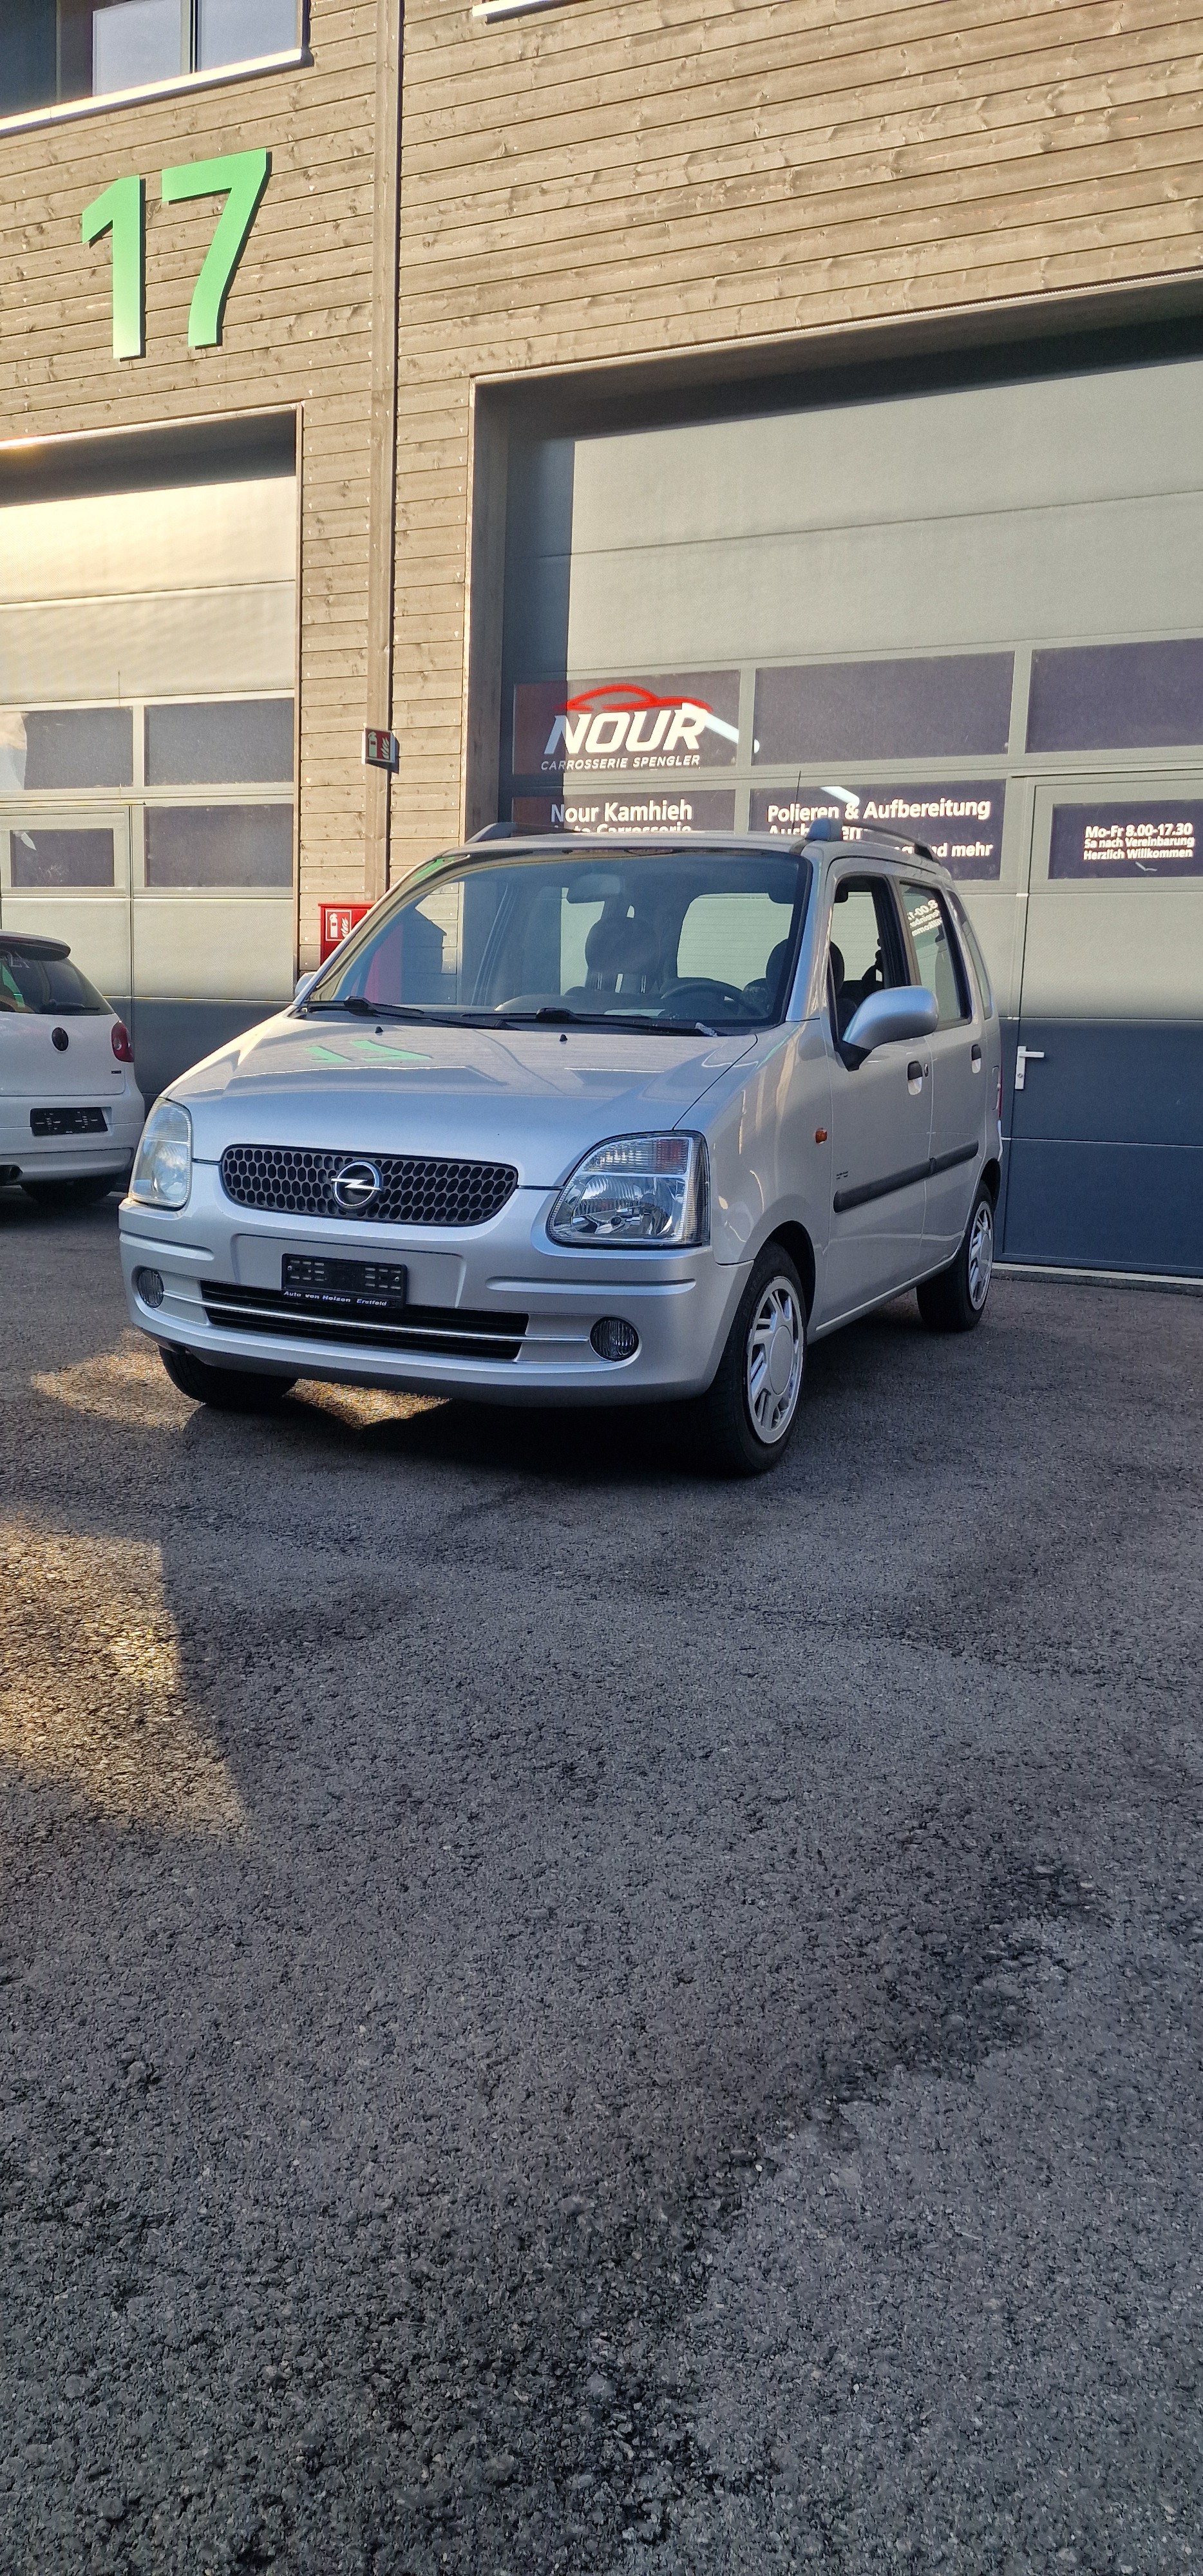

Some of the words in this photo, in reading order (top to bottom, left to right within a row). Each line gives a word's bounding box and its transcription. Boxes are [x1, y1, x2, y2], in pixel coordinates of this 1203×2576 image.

[82, 147, 267, 359] 17
[544, 708, 708, 754] NOUR
[541, 757, 628, 770] CARROSSERIE
[633, 755, 700, 768] SPENGLER
[551, 804, 599, 822] Nour
[604, 799, 692, 822] Kamhieh
[768, 803, 838, 822] Polieren
[845, 802, 859, 819] &
[863, 798, 990, 820] Aufbereitung
[1085, 826, 1124, 838] Mo-Fr
[1126, 822, 1193, 837] 8.00-17.30
[951, 842, 994, 857] mehr
[1085, 838, 1097, 848] Sa
[1099, 838, 1123, 848] nach
[1125, 836, 1195, 848] Vereinbarung
[1083, 849, 1124, 860] Herzlich
[1127, 848, 1193, 859] Willkommen
